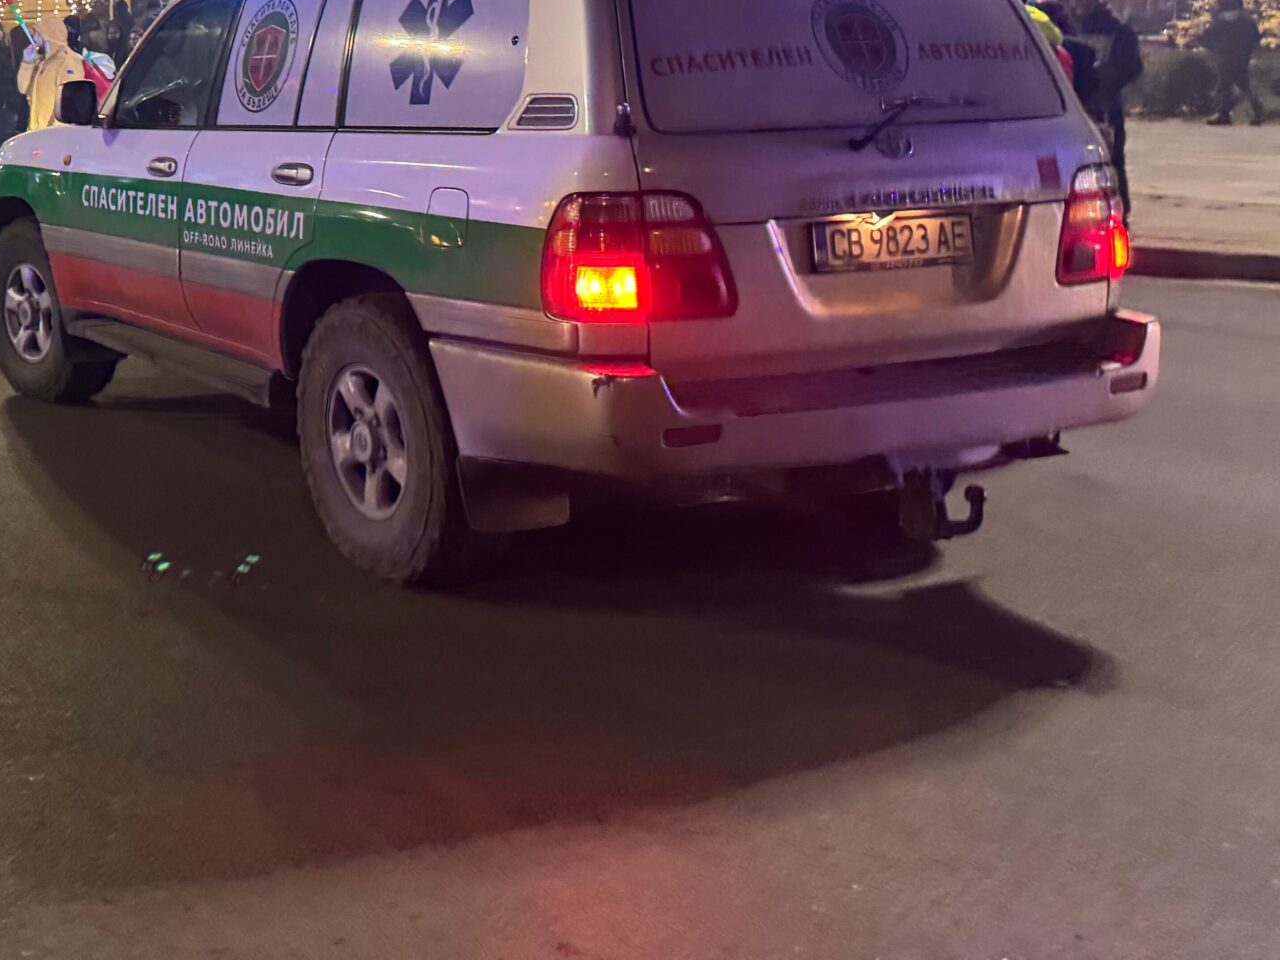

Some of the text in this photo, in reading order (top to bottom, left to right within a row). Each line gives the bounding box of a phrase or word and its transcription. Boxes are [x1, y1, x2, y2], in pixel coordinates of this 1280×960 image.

[650, 46, 813, 76] СПАСИТЕЛЕН
[81, 184, 304, 239] СПАСИТЕЛЕН АВТОМОБИЛ
[183, 230, 273, 258] OFF-ROAD ЛИНЕЙКА
[870, 223, 930, 258] 9823
